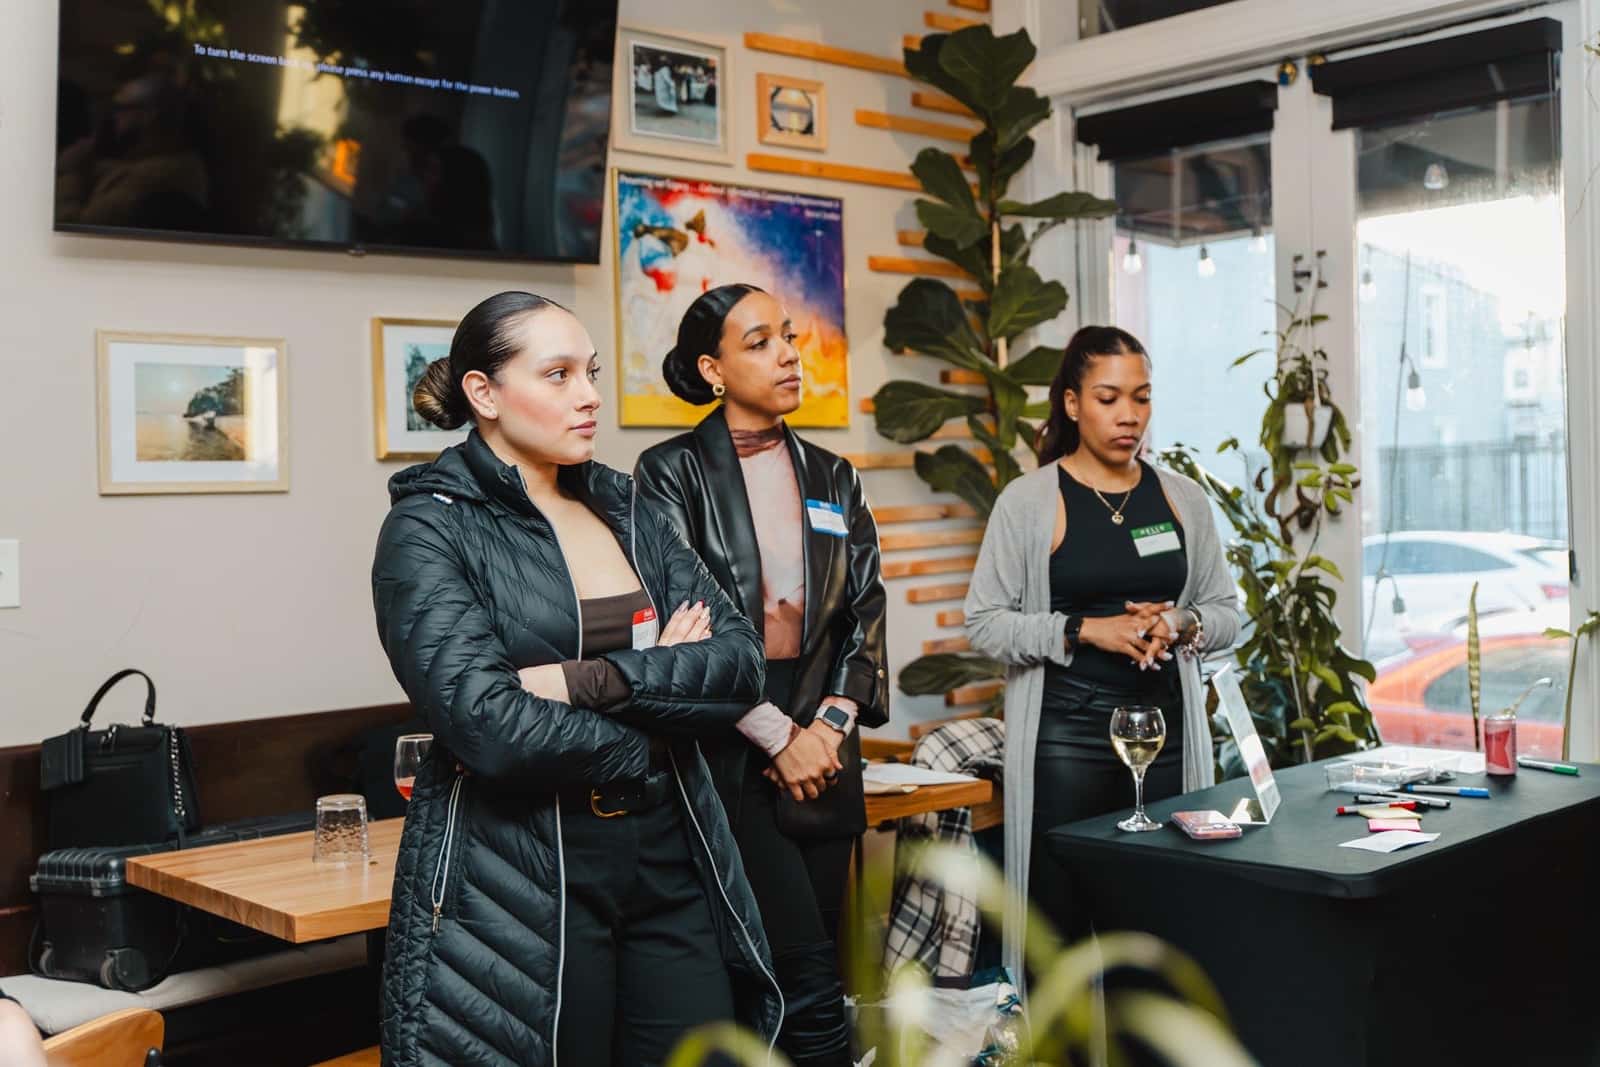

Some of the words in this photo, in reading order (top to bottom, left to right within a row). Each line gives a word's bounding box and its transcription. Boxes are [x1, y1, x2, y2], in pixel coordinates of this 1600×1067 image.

[194, 43, 206, 56] To
[207, 47, 228, 58] turn
[229, 49, 246, 61] the
[247, 53, 277, 65] screen
